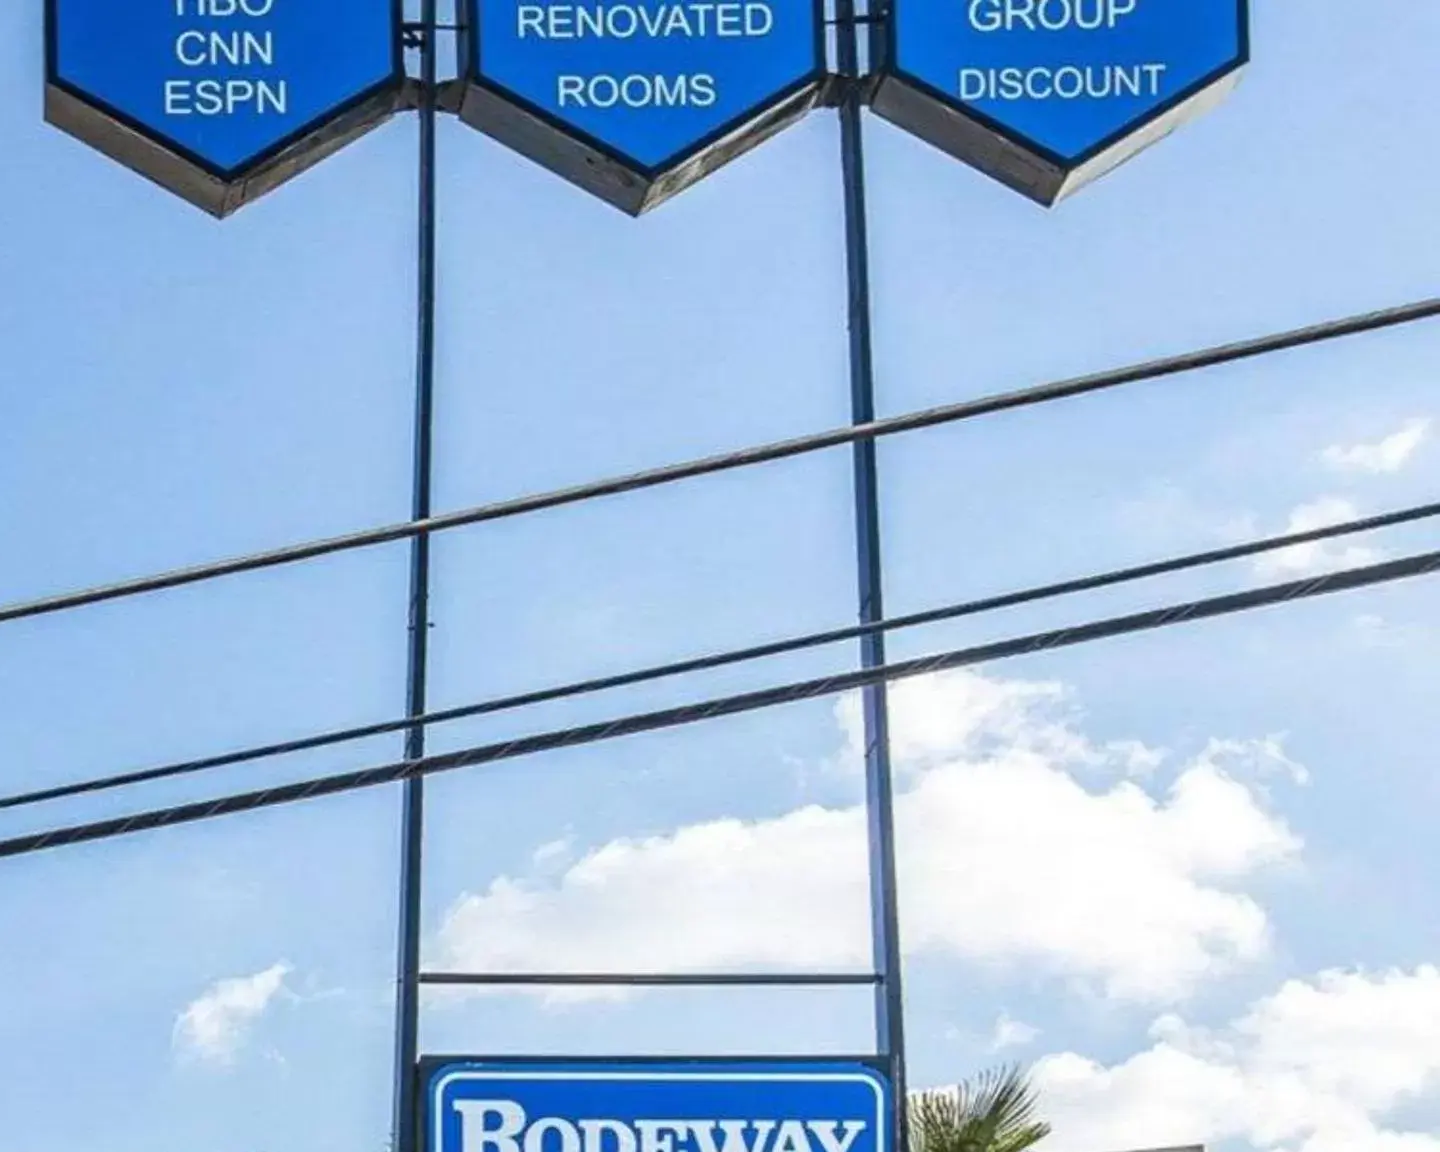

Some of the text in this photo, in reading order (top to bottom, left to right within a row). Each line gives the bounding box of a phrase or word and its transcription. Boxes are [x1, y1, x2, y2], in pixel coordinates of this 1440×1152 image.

[517, 3, 773, 38] RENOVATED
[968, 0, 1136, 31] GROUP
[176, 30, 272, 66] CNN
[165, 80, 286, 115] ESPN
[558, 74, 716, 107] ROOMS
[960, 64, 1166, 100] DISCOUNT
